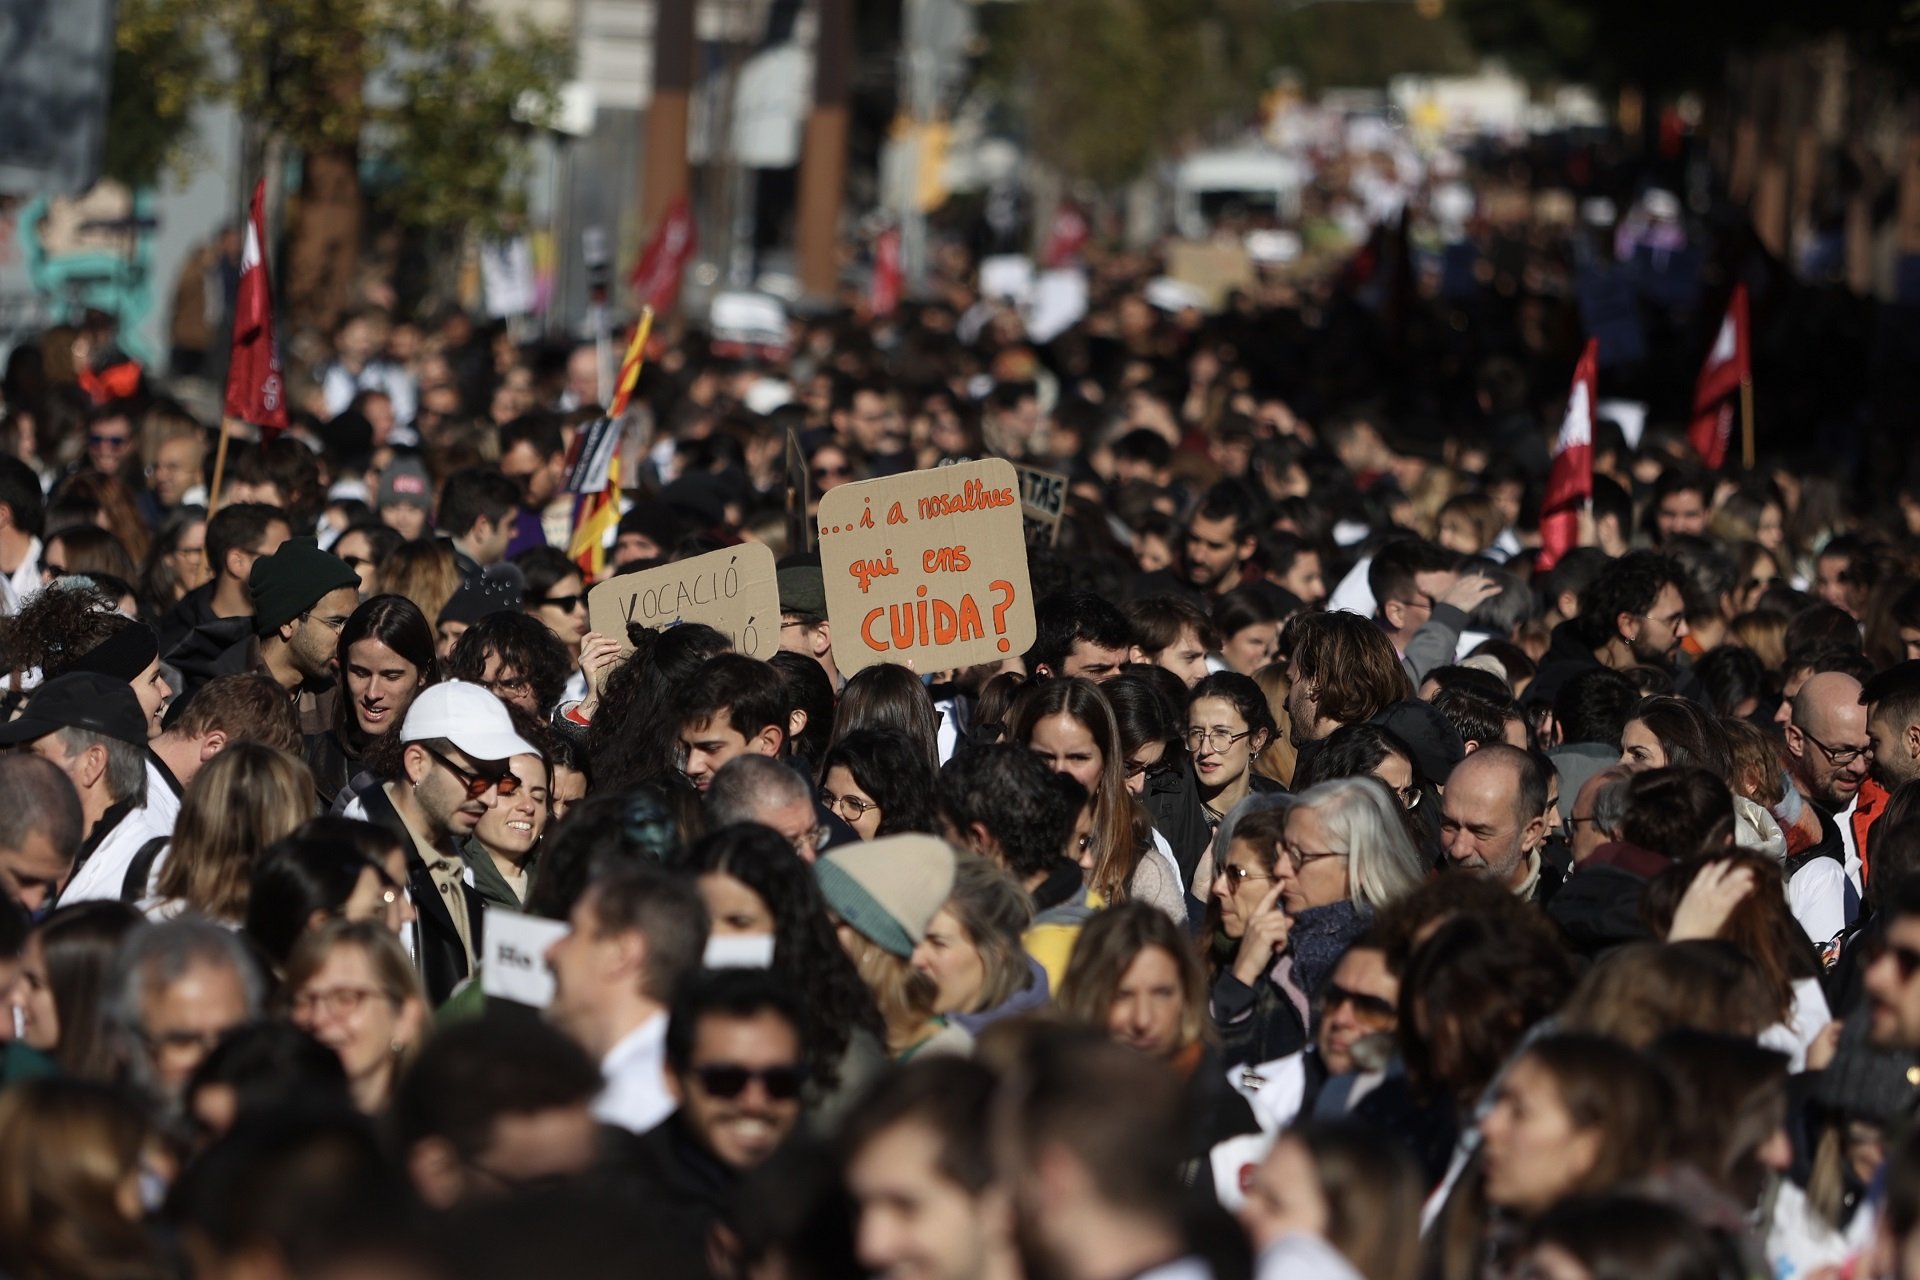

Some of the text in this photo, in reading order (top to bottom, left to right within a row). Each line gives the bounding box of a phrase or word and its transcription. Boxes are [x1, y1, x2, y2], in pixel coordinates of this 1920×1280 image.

[887, 501, 908, 525] a
[918, 478, 1015, 520] nosaltres
[619, 556, 738, 624] VOCACIÓ
[849, 545, 971, 594] qui ens
